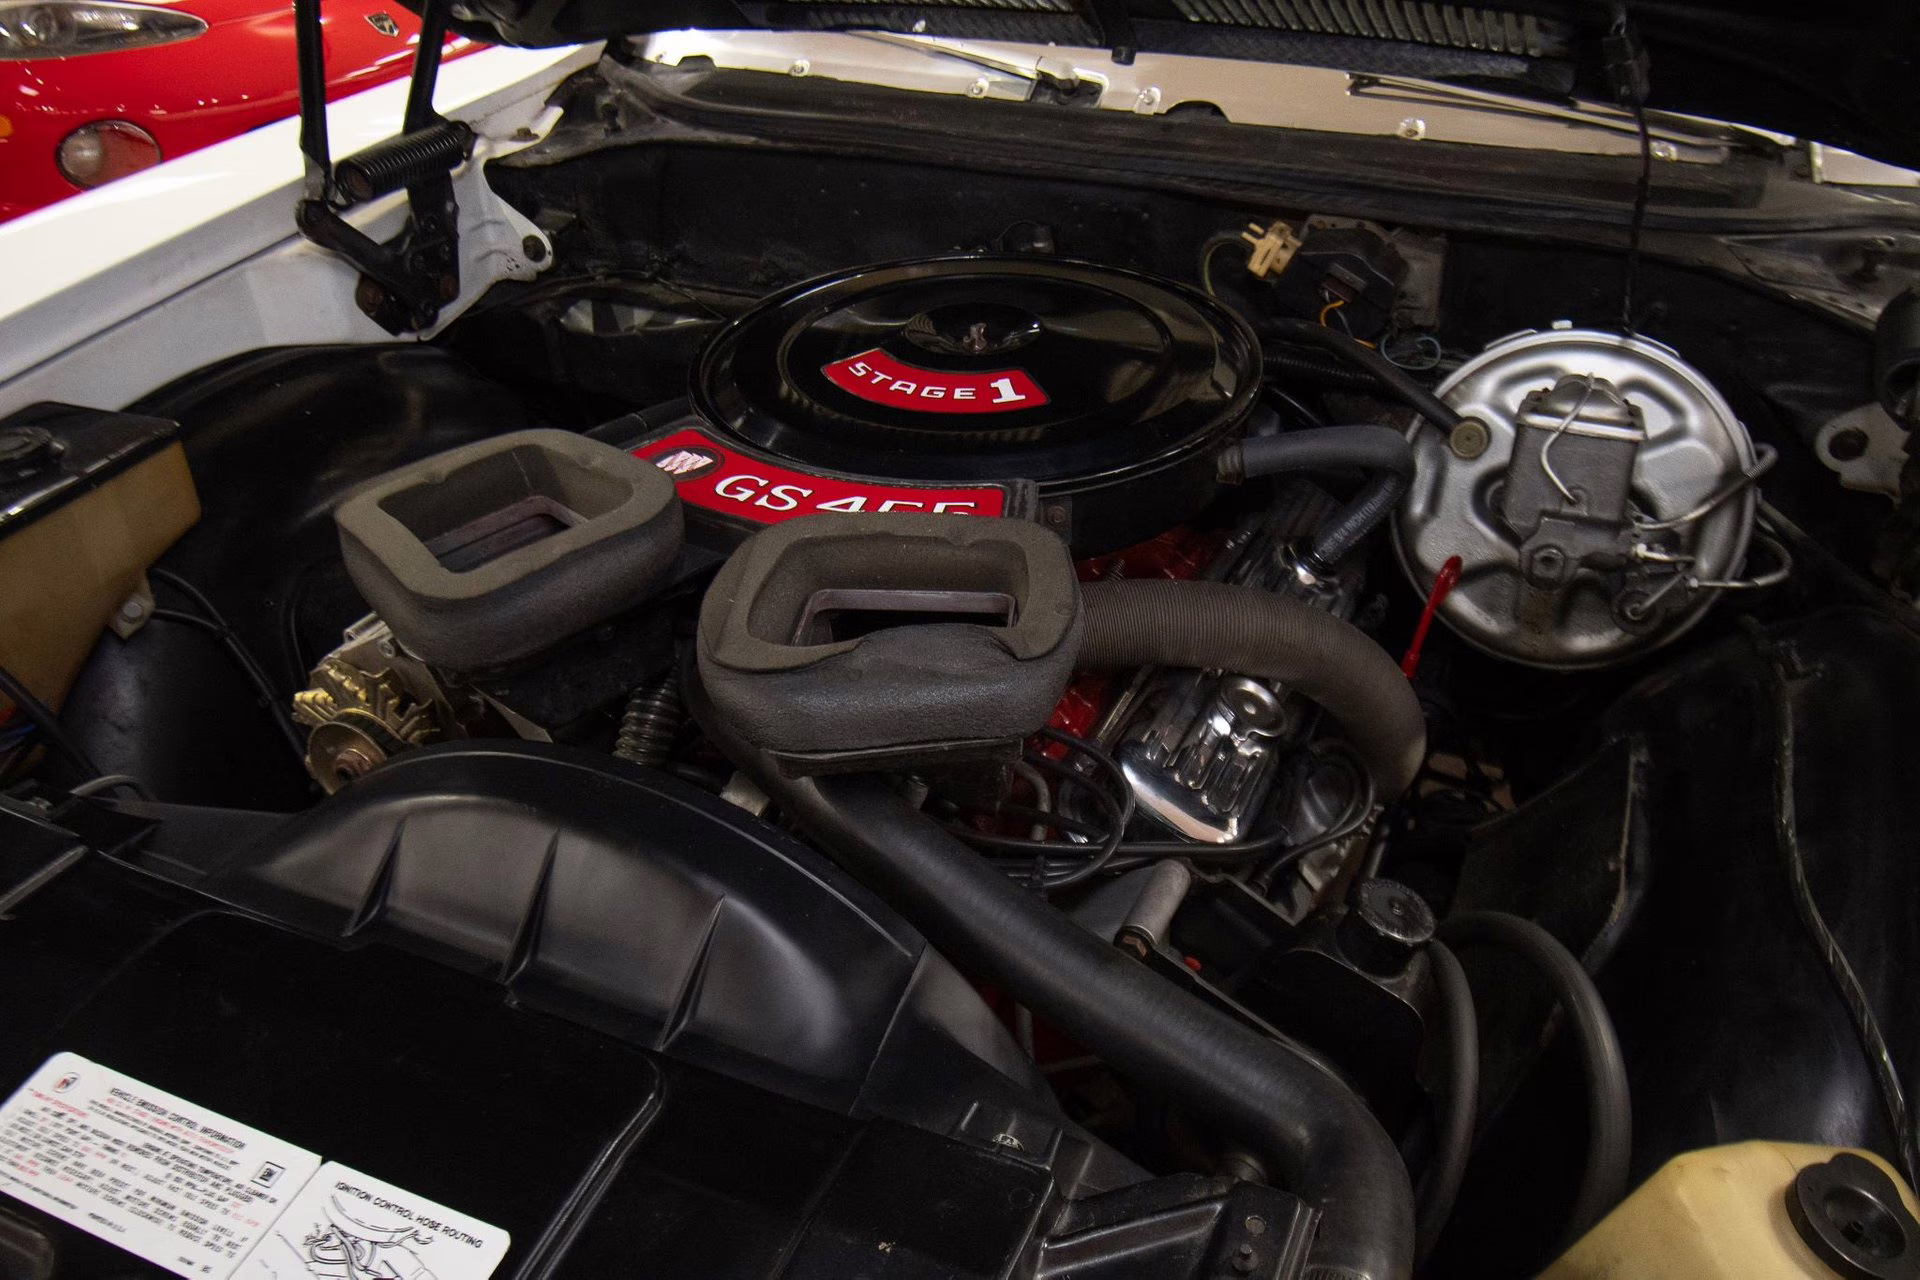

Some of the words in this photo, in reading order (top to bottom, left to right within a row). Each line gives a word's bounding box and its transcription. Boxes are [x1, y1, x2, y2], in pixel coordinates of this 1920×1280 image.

[848, 361, 977, 400] STAGE
[990, 377, 1026, 404] 1
[714, 474, 814, 511] GS
[168, 1113, 199, 1129] CONTROL
[200, 1126, 246, 1149] INFORMATION
[334, 1181, 371, 1202] IGNITION
[373, 1197, 413, 1220] CONTROL
[416, 1214, 442, 1231] HOSE
[442, 1225, 483, 1248] ROUTING
